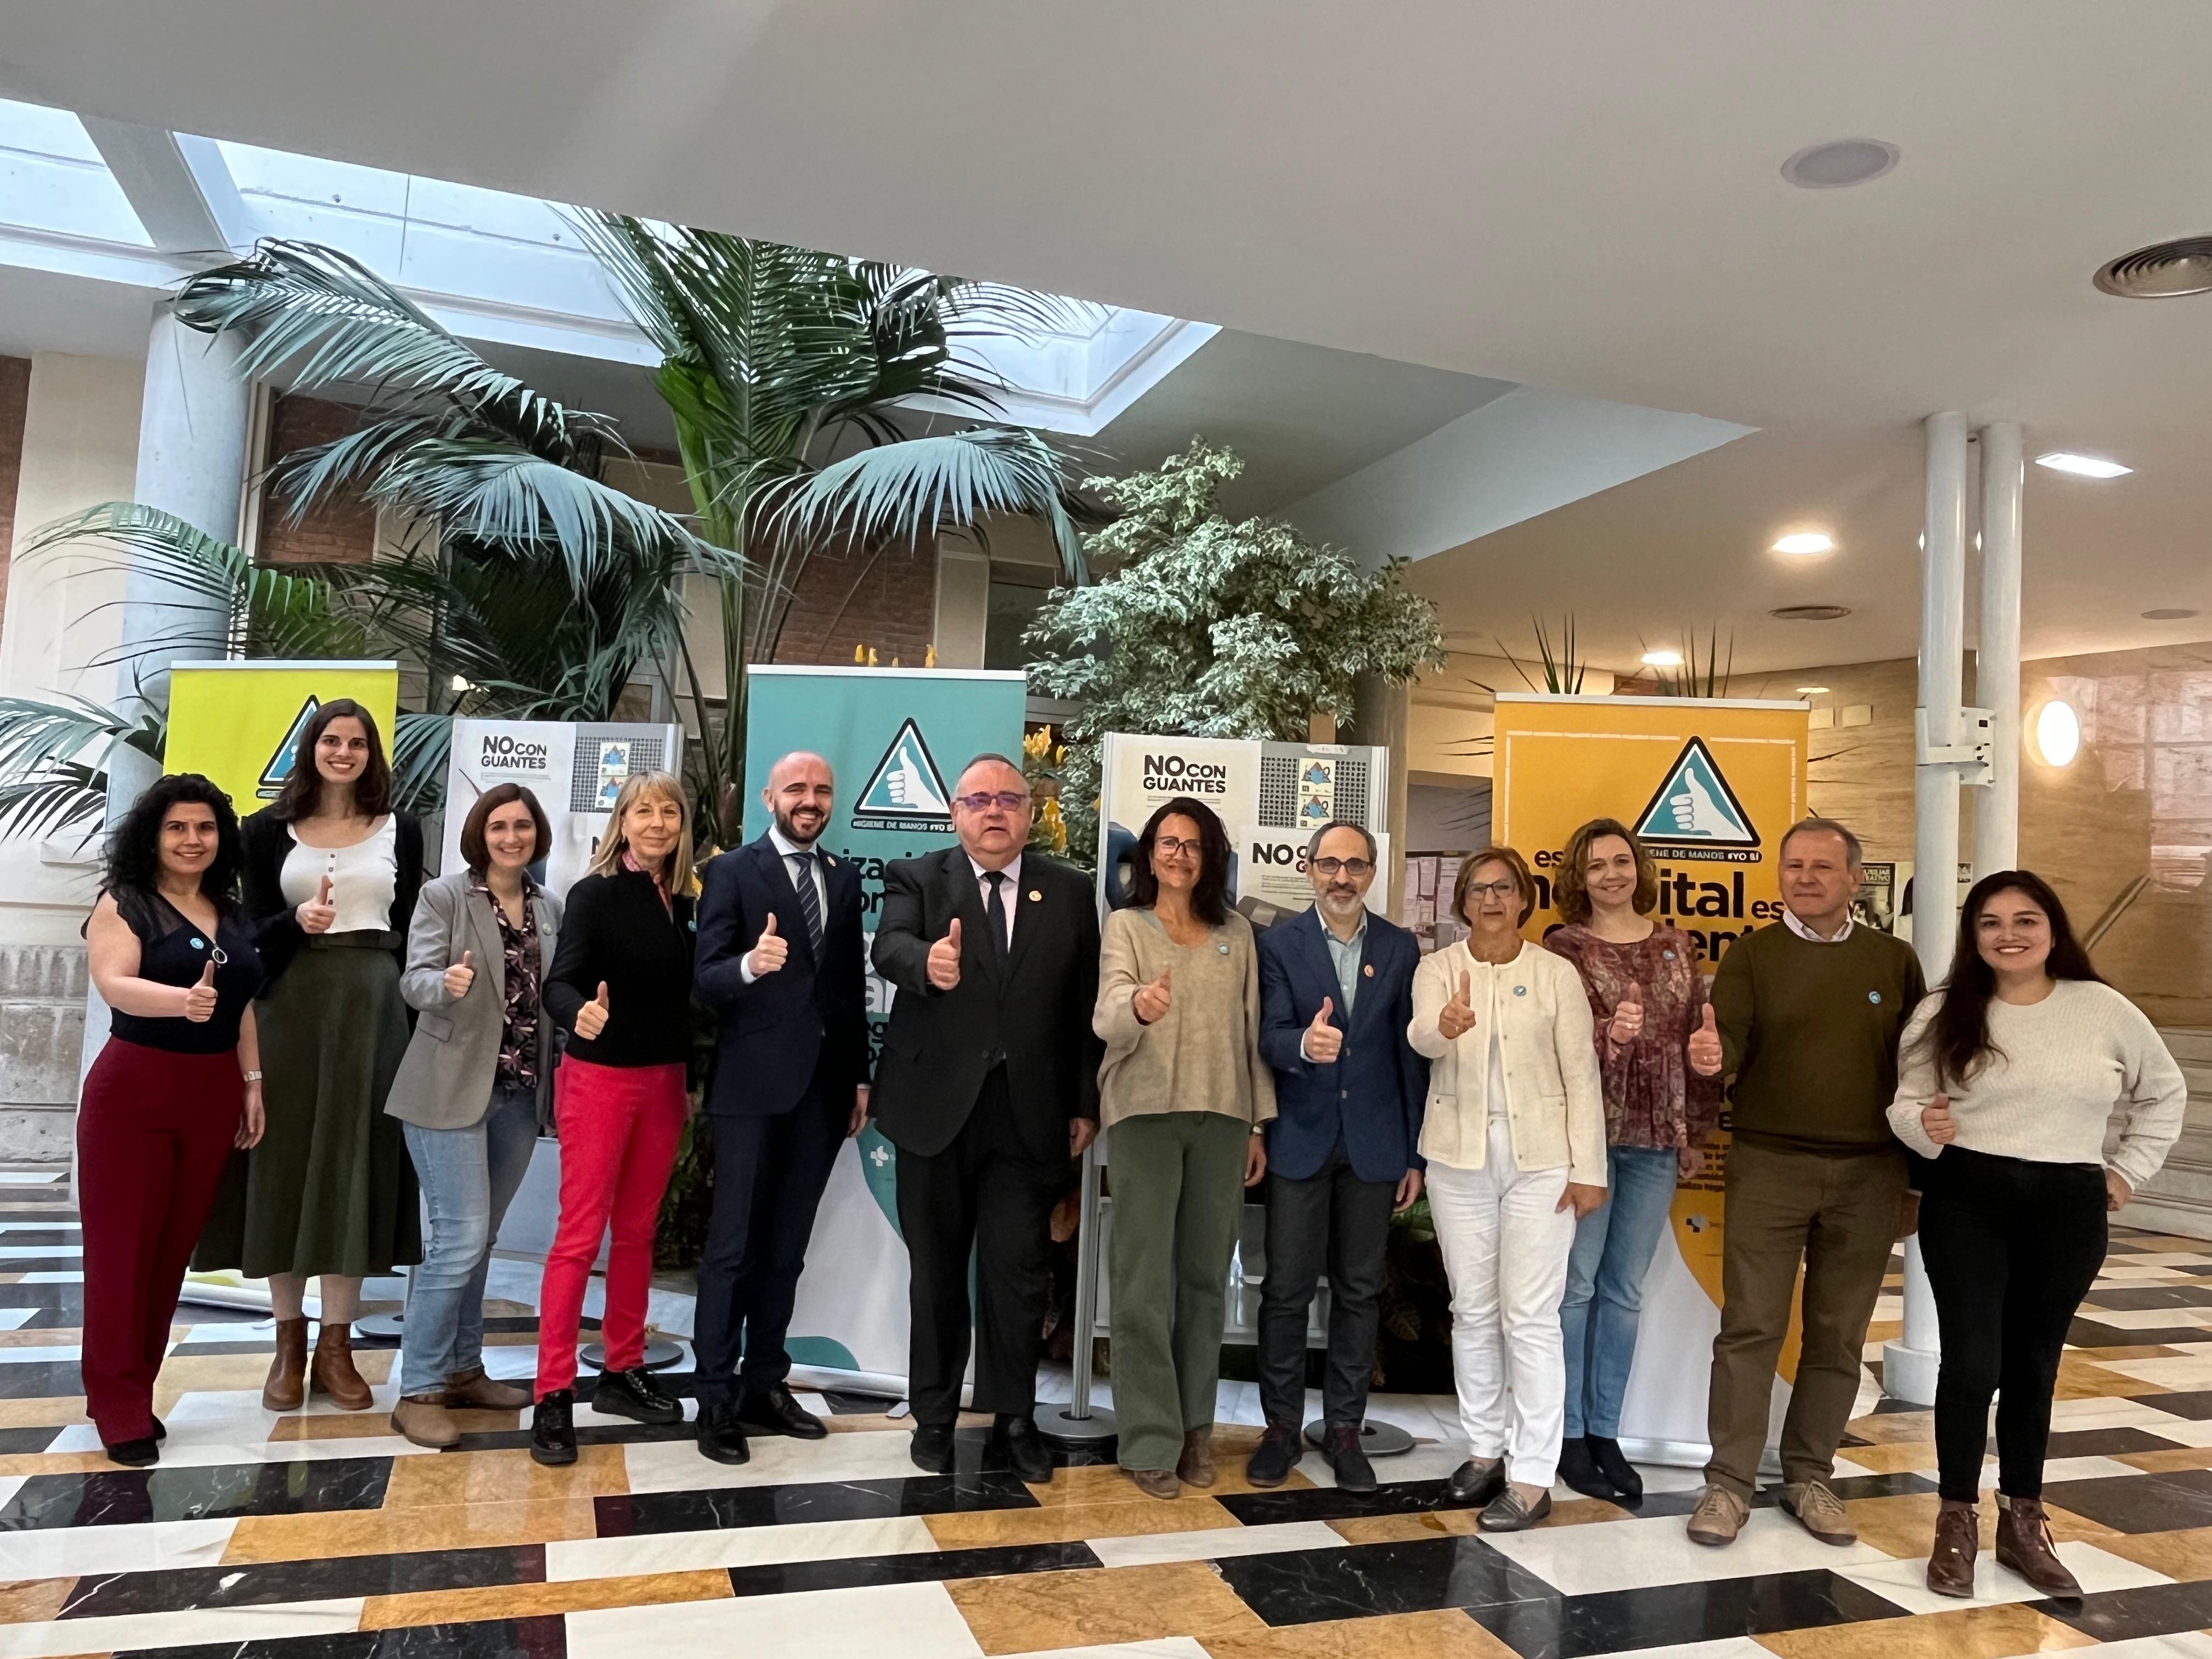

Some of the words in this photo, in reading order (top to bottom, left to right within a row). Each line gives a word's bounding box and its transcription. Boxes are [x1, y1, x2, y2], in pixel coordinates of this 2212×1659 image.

[483, 736, 514, 754] NO
[515, 743, 546, 755] CON
[481, 755, 546, 769] GUANTES
[1144, 754, 1185, 776] NO
[1186, 764, 1226, 778] CON
[1143, 777, 1226, 793] GUANTES
[1252, 843, 1294, 865] NO
[1751, 900, 1785, 920] es
